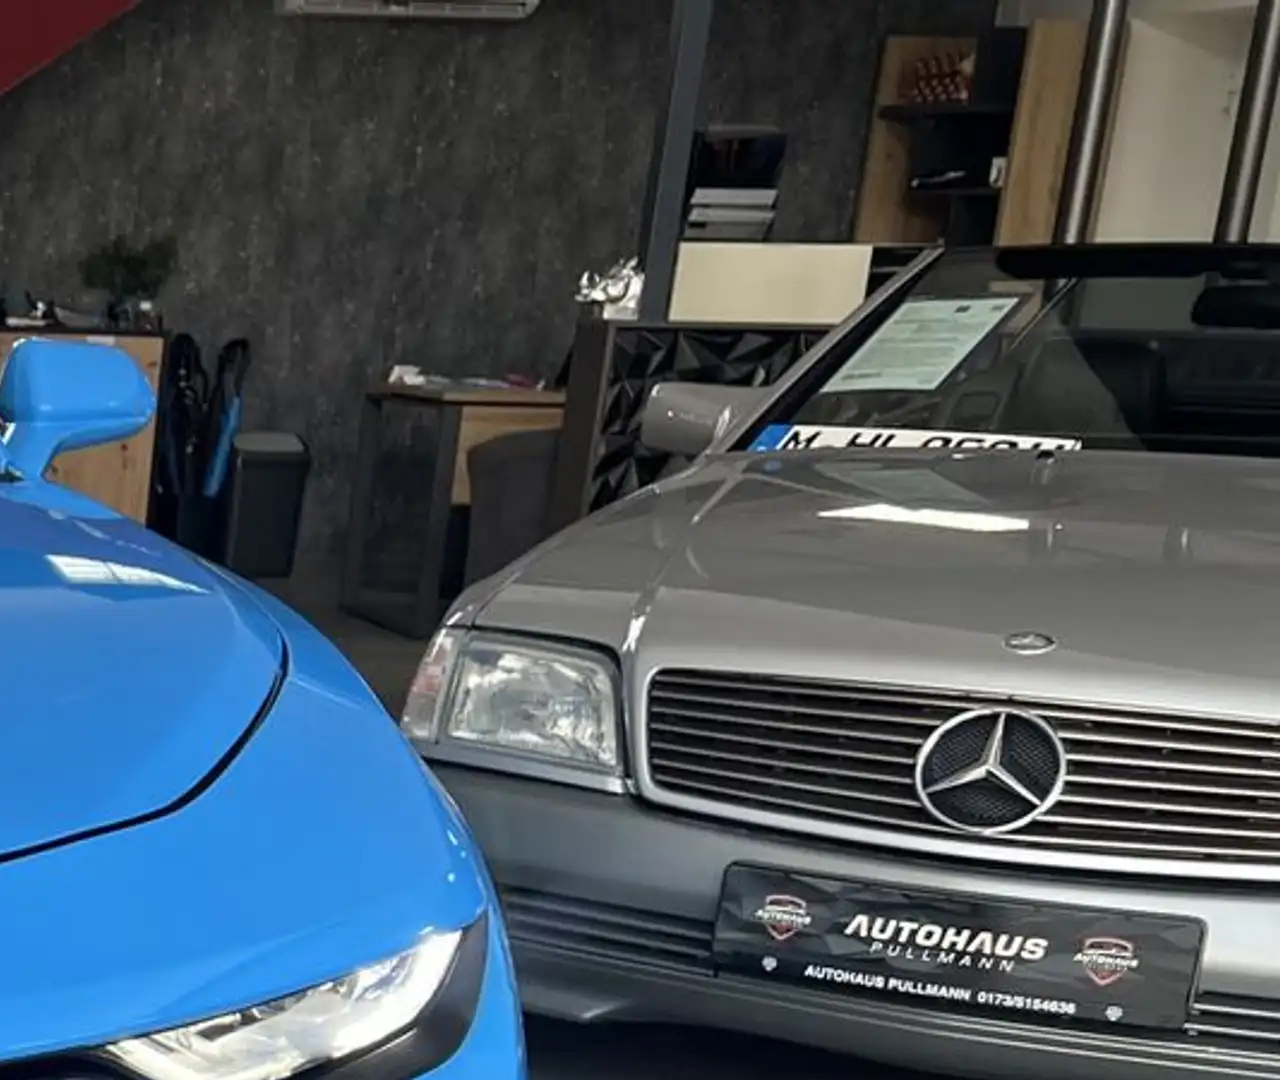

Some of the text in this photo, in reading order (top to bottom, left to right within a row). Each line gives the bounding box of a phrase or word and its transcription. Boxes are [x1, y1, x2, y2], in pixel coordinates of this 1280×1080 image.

[844, 913, 1049, 961] AUTOHAUS
[869, 941, 1016, 973] PULLMANN
[804, 964, 885, 989] AUTOHAUS
[887, 978, 972, 1001] PULLMANN
